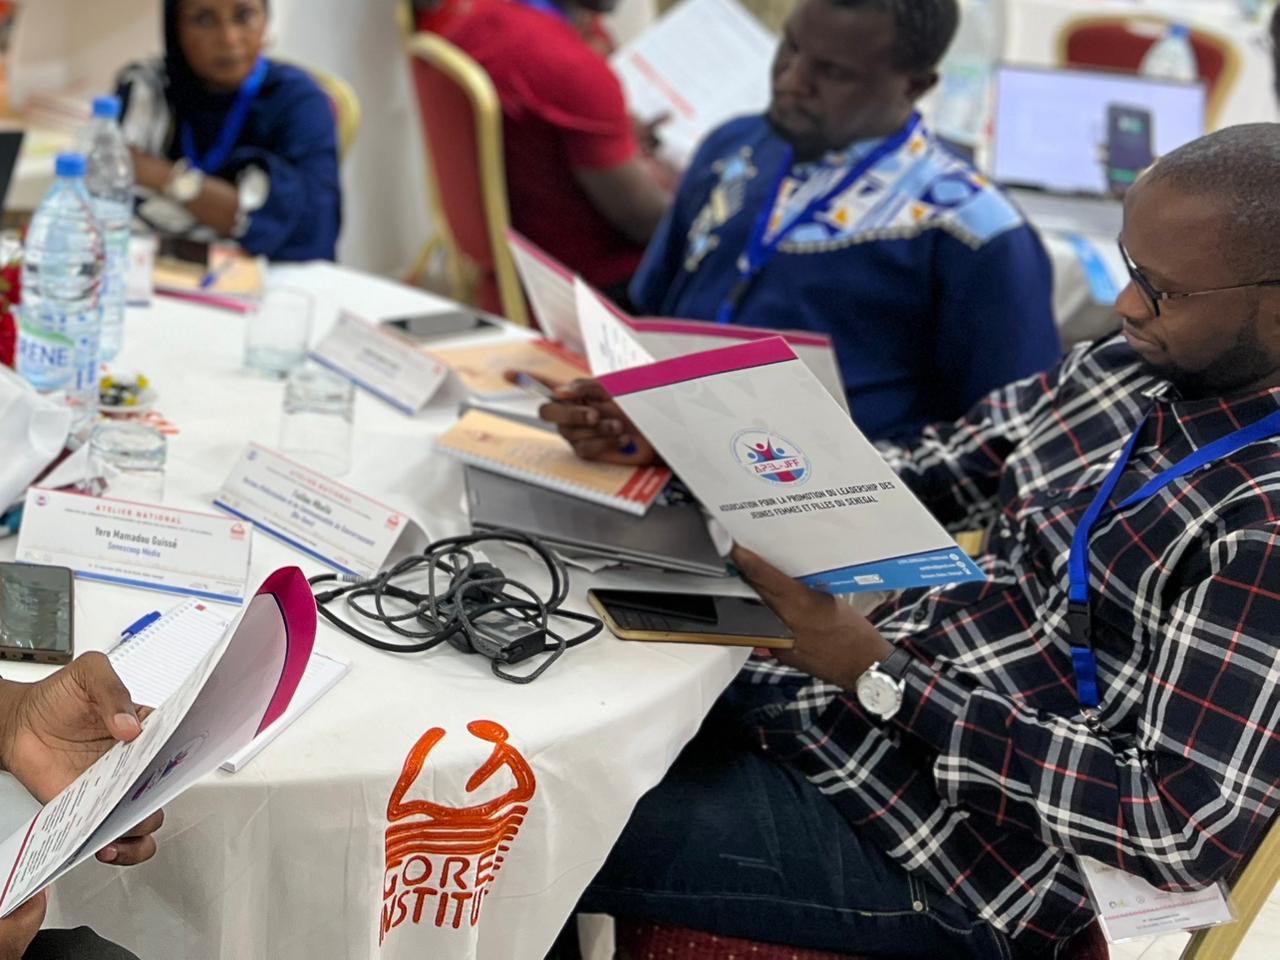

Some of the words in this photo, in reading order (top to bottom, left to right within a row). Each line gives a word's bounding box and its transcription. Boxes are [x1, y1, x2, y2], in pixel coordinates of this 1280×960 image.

[719, 501, 758, 512] ASSOCIATION
[758, 498, 776, 508] POUR
[776, 496, 789, 505] LA
[787, 491, 827, 503] PROMOTION
[826, 489, 836, 497] DU
[836, 483, 878, 496] LEADERSHIP
[879, 481, 896, 491] DES
[136, 510, 182, 525] NATIONAL
[751, 510, 775, 520] JEUNES
[774, 506, 803, 517] FEMMES
[802, 503, 814, 512] ET
[811, 500, 836, 510] FILLES
[834, 499, 846, 508] DU
[845, 495, 879, 507] SENEGAL
[113, 529, 150, 544] Mamadou
